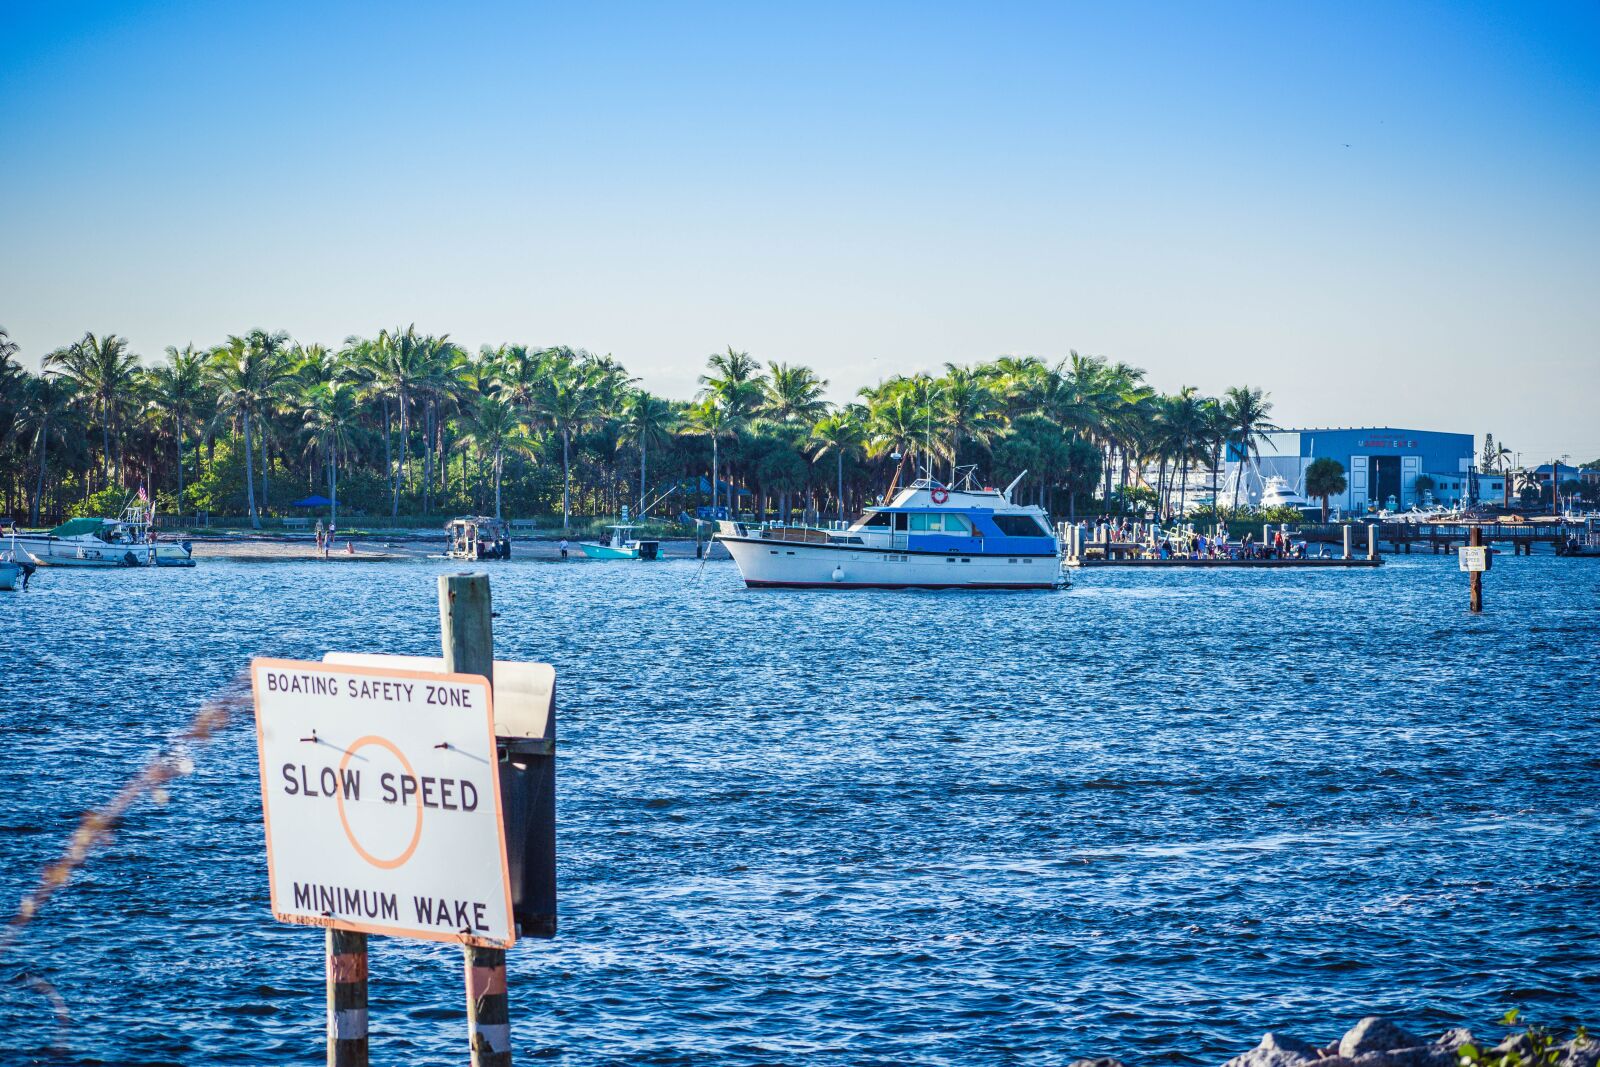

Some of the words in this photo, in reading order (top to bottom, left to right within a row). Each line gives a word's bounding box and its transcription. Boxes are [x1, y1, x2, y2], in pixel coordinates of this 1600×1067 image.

[267, 673, 338, 696] BOATING
[349, 679, 414, 703] SAFETY
[427, 685, 472, 708] ZONE
[282, 763, 361, 801] SLOW
[381, 773, 478, 812] SPEED
[278, 913, 292, 924] FAC
[293, 882, 399, 921] MINIMUM
[414, 896, 490, 931] WAKE
